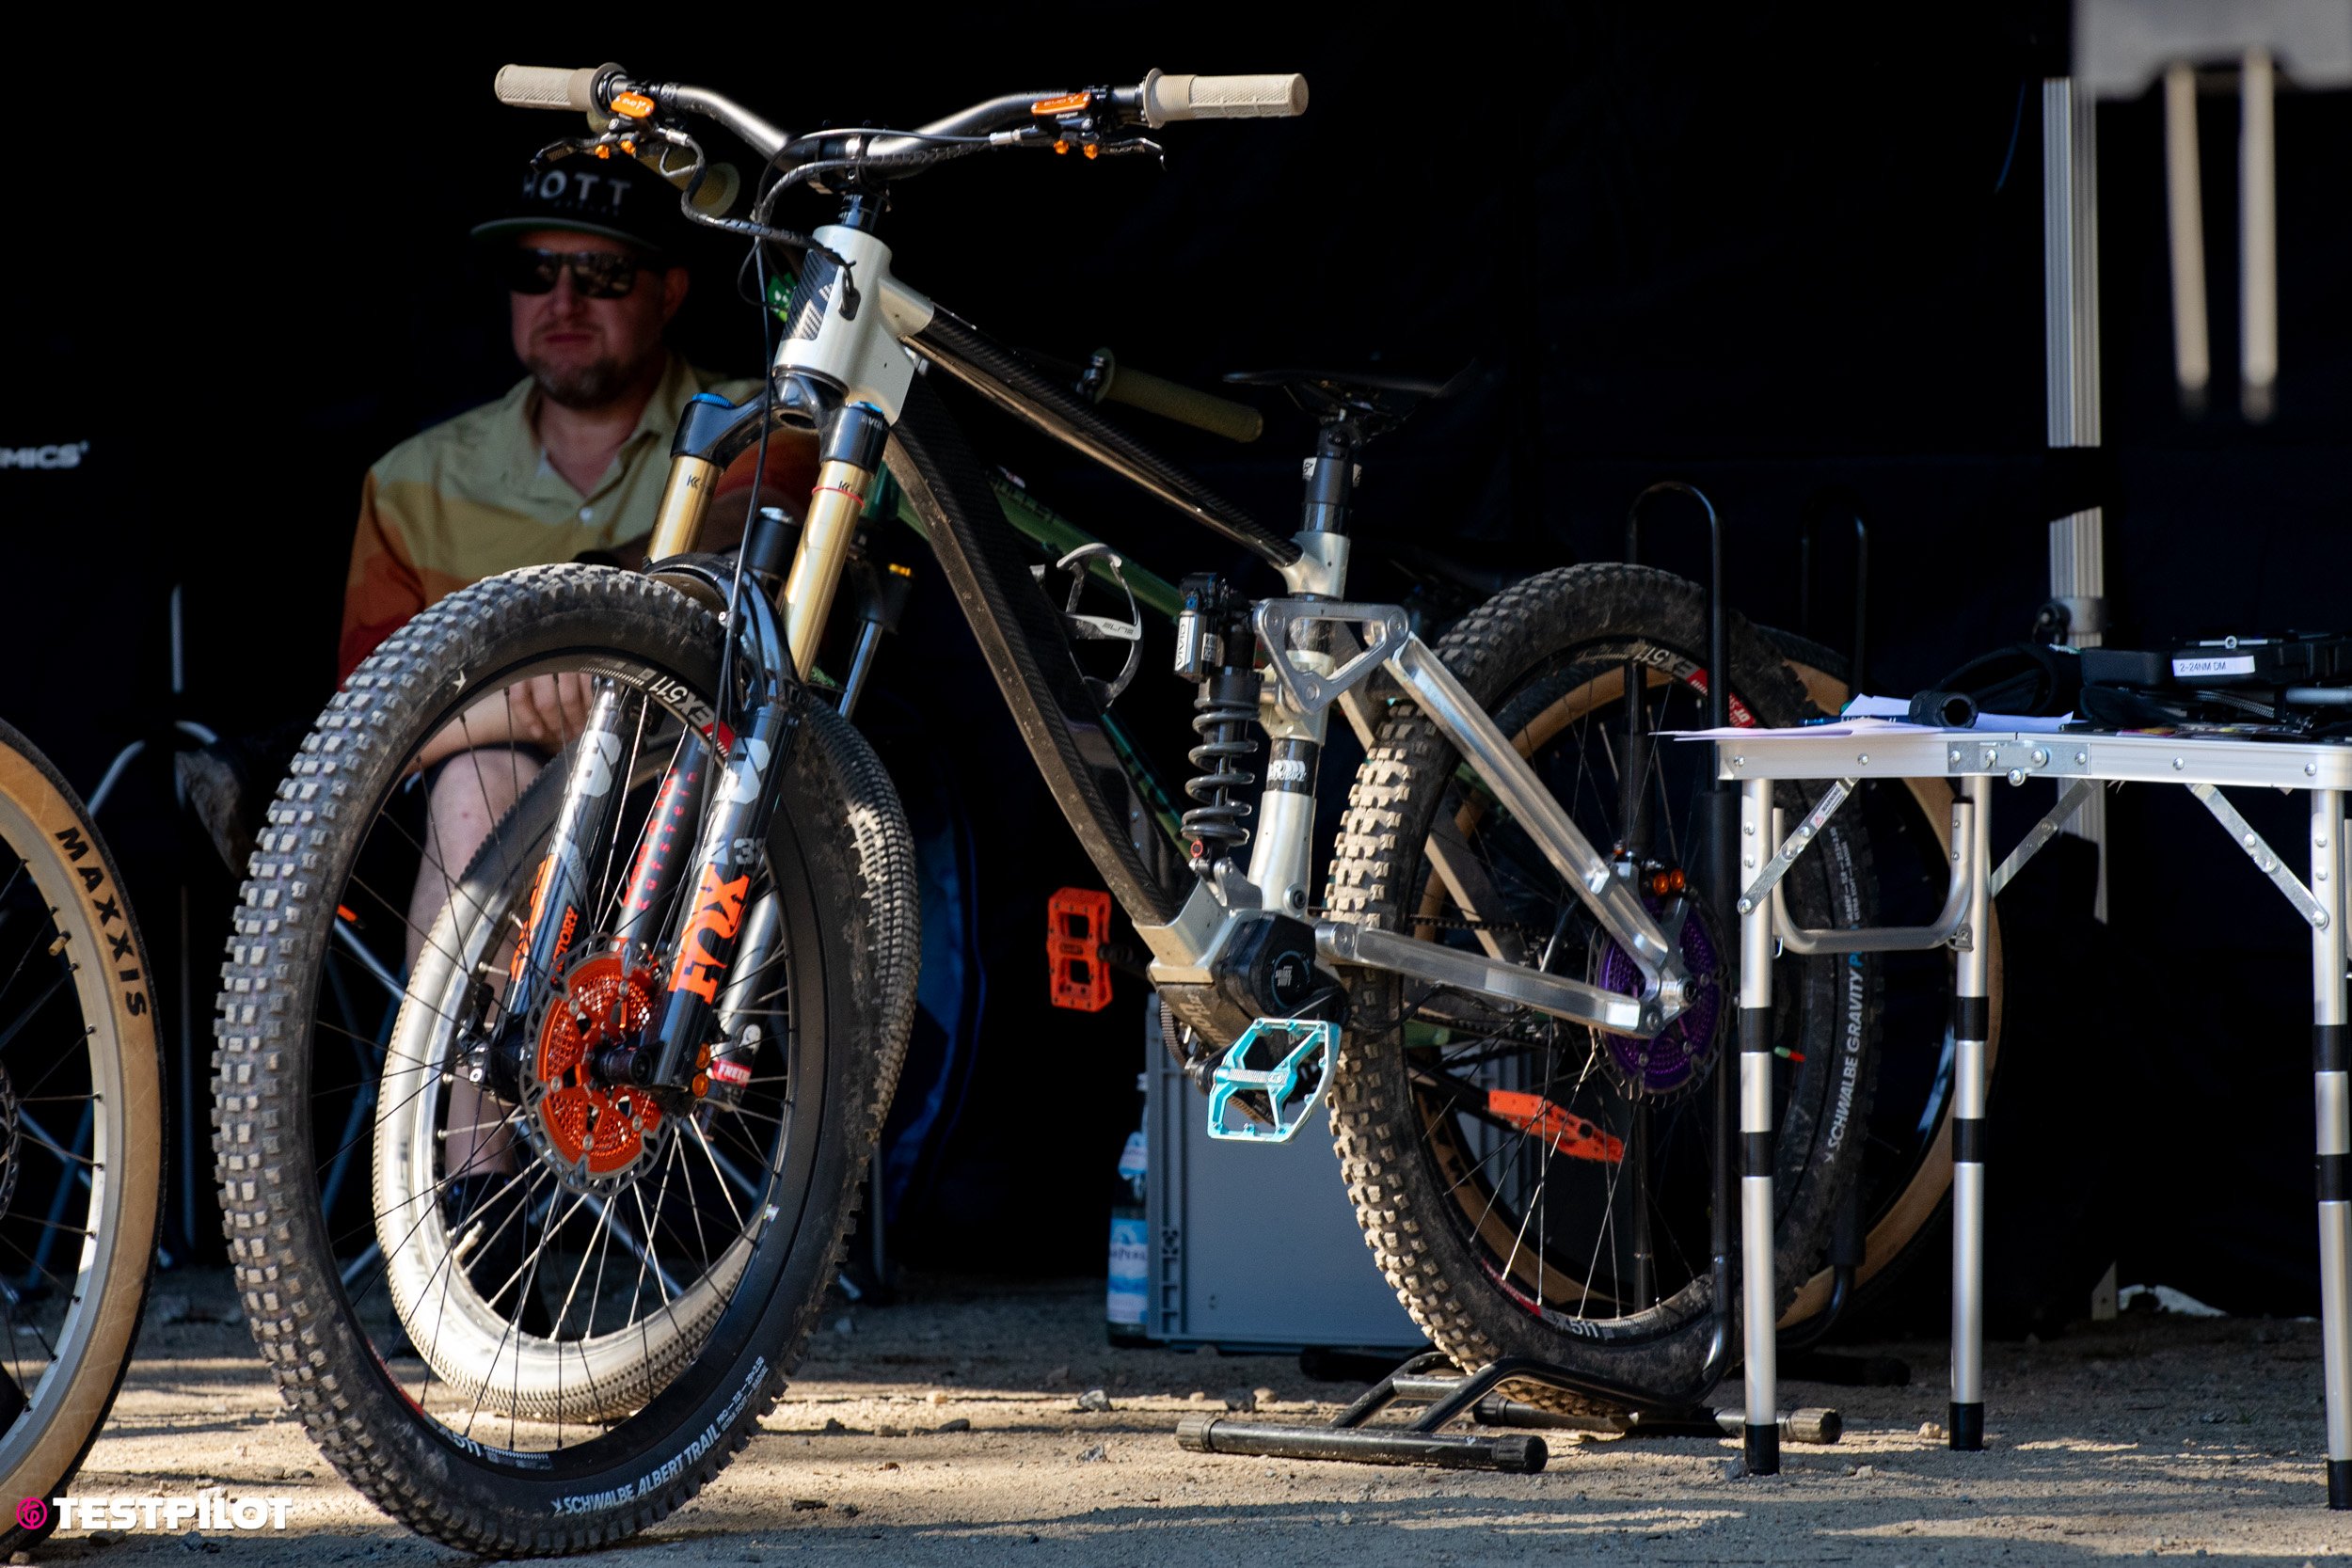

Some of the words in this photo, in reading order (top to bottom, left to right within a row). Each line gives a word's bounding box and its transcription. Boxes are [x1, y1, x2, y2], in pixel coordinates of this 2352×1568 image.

[0, 443, 81, 469] MICS
[648, 675, 716, 728] EX511
[55, 826, 147, 1017] MAXXIS
[667, 863, 751, 1005] FOX
[1827, 1056, 1859, 1152] SCHWALBE
[1846, 969, 1864, 1053] GRAVITY
[564, 1483, 634, 1515] SCHWALBE
[637, 1457, 686, 1497] ALBERT
[684, 1423, 722, 1466] TRAIL
